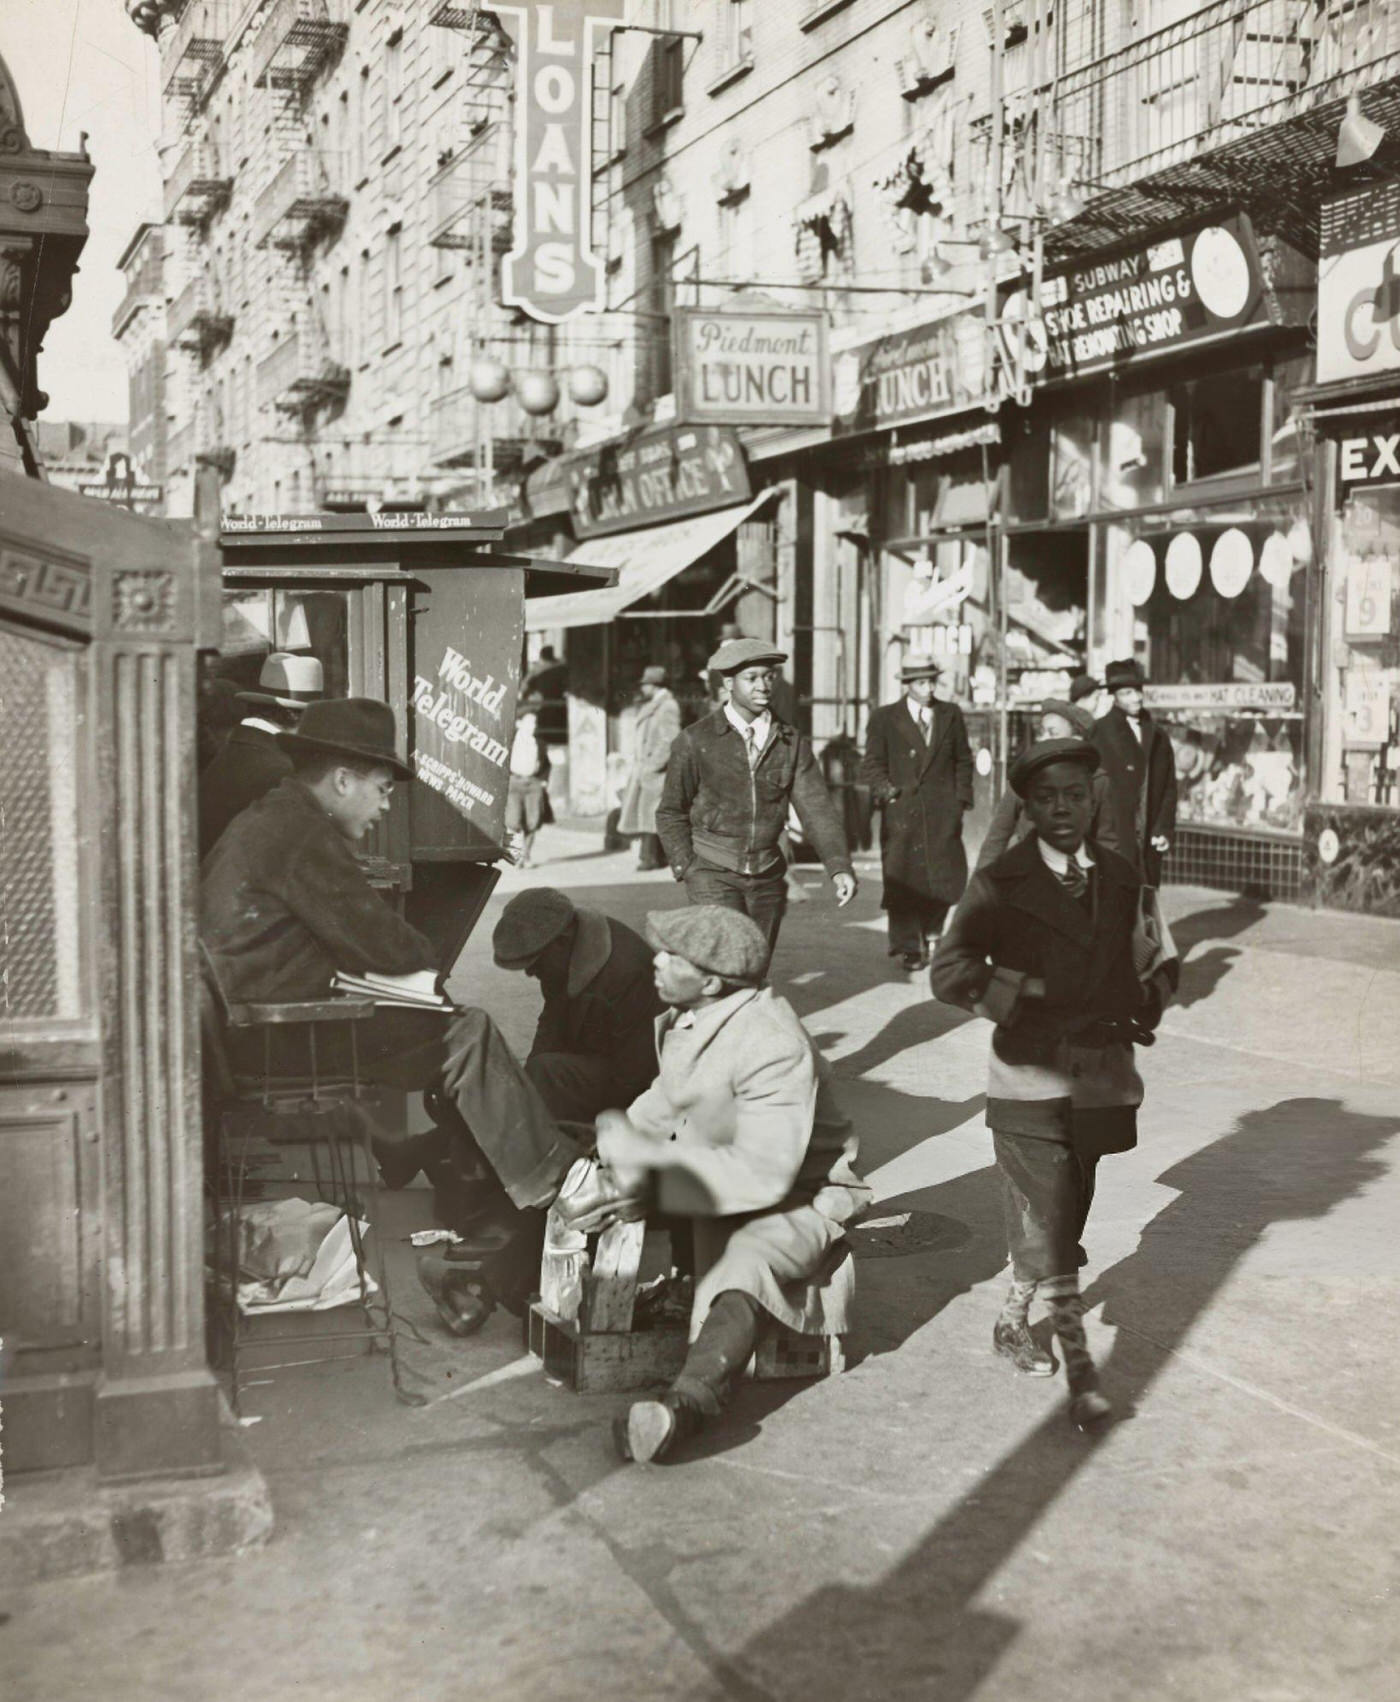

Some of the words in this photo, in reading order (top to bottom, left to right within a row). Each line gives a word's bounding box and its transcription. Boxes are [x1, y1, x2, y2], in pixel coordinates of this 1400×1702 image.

[531, 4, 575, 295] LOANS
[1073, 255, 1140, 293] SUBWAY
[1044, 303, 1088, 337] SHOE
[1086, 275, 1176, 325] REPAIRING
[1175, 269, 1191, 298] &
[696, 322, 812, 355] Piedmont
[1143, 307, 1183, 342] SHOP
[701, 363, 811, 404] LUNCH
[371, 511, 472, 528] World-Telegram
[438, 646, 507, 716] World
[411, 675, 509, 767] Telegram
[416, 767, 444, 791] NEWS
[444, 785, 475, 811] PAPER
